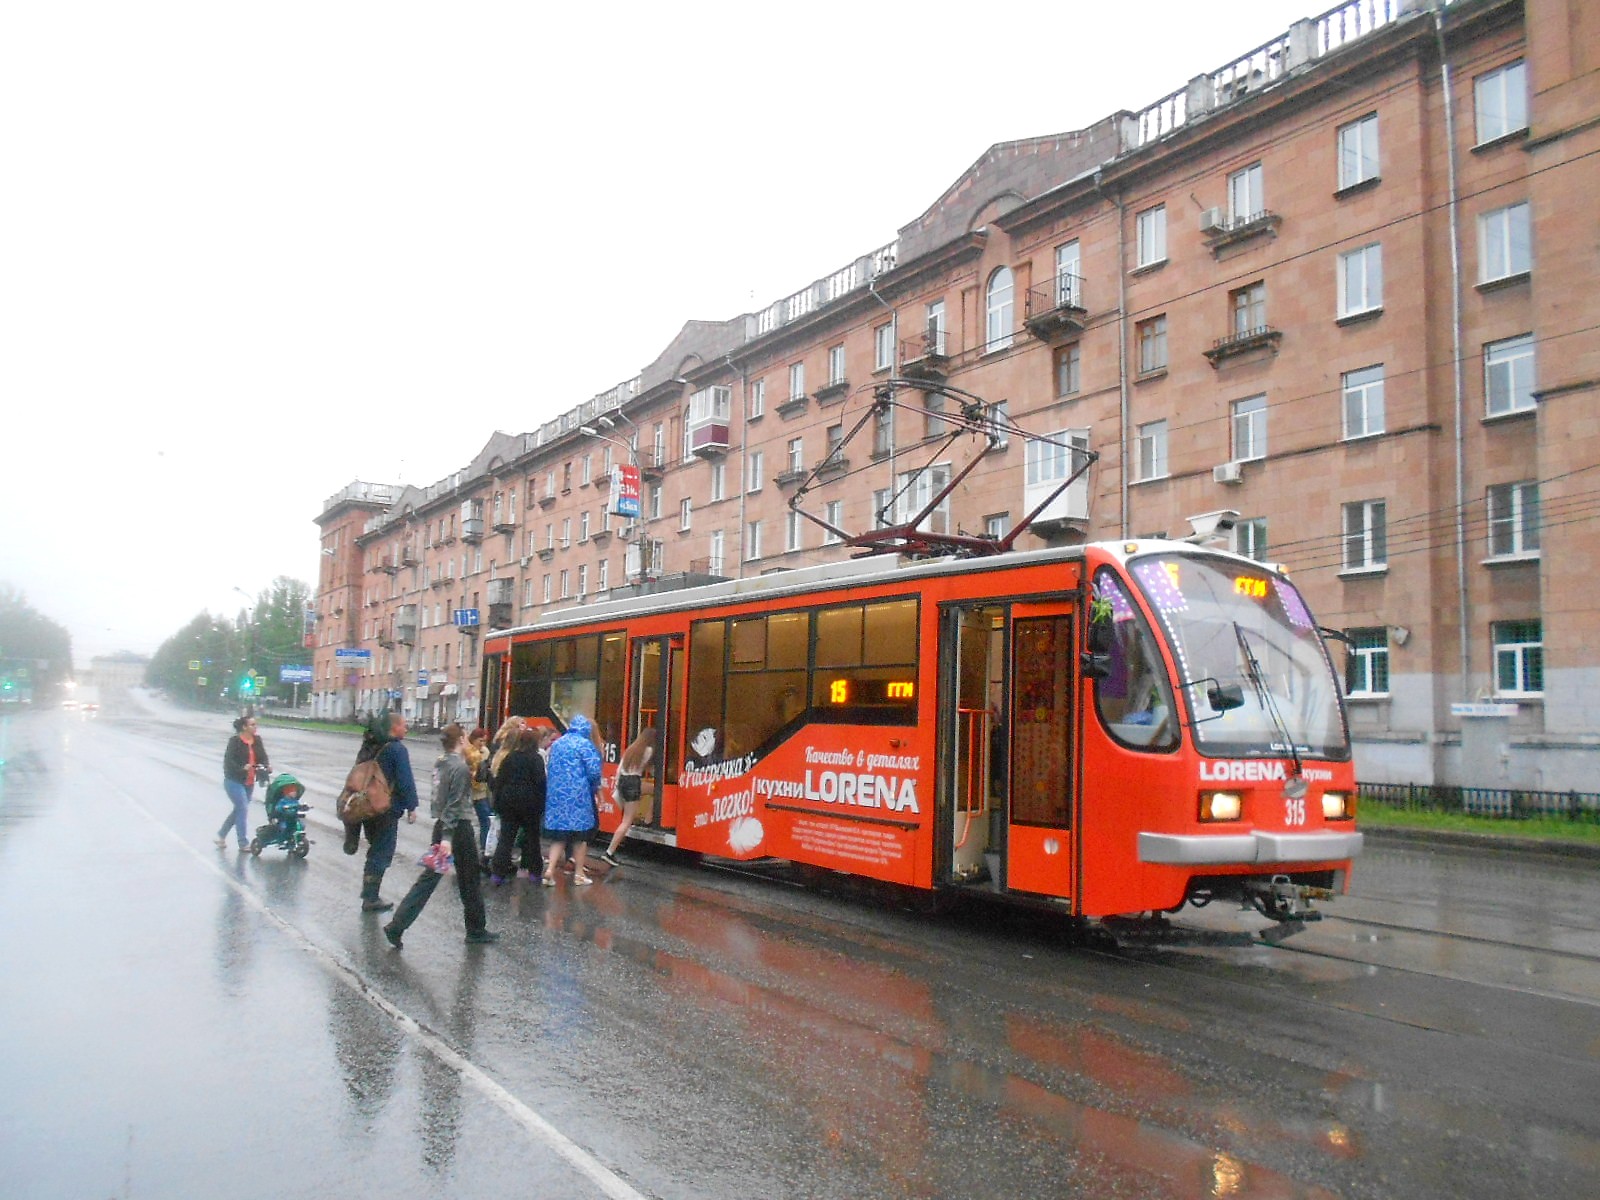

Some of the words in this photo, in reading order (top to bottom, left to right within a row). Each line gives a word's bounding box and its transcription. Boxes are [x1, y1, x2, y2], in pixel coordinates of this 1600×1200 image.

[830, 679, 847, 703] 15
[805, 746, 854, 766] Качество
[856, 750, 865, 767] в
[867, 753, 920, 772] деталях
[1199, 761, 1287, 781] LORENA
[710, 776, 757, 823] легко!
[756, 778, 804, 800] кухни
[805, 769, 920, 814] LORENA
[1285, 799, 1305, 825] 315
